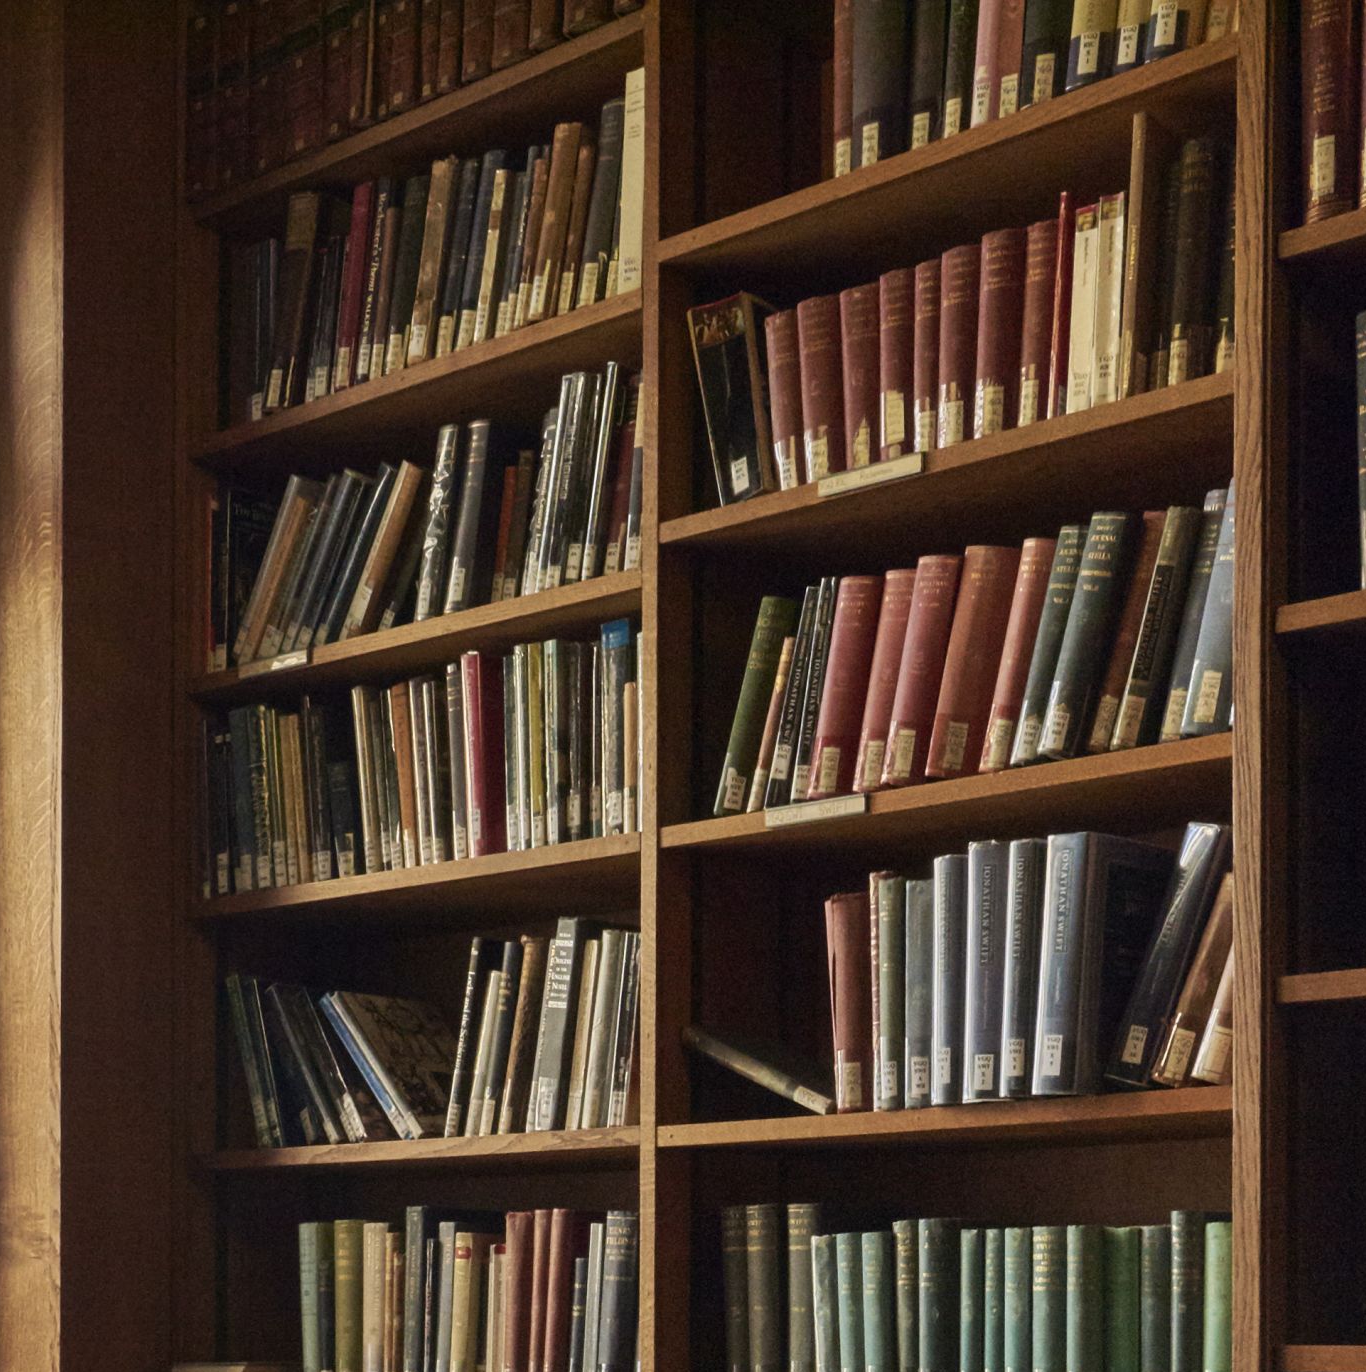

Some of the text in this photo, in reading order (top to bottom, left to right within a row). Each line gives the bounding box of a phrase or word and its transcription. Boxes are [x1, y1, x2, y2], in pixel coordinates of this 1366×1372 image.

[372, 192, 387, 256] Rochester's
[804, 658, 822, 746] JONATHAN SWIFT
[982, 866, 991, 926] JONATHAN
[1013, 857, 1025, 958] JONATHAN SWIFT
[1055, 849, 1070, 951] JONATHAN SWIFT
